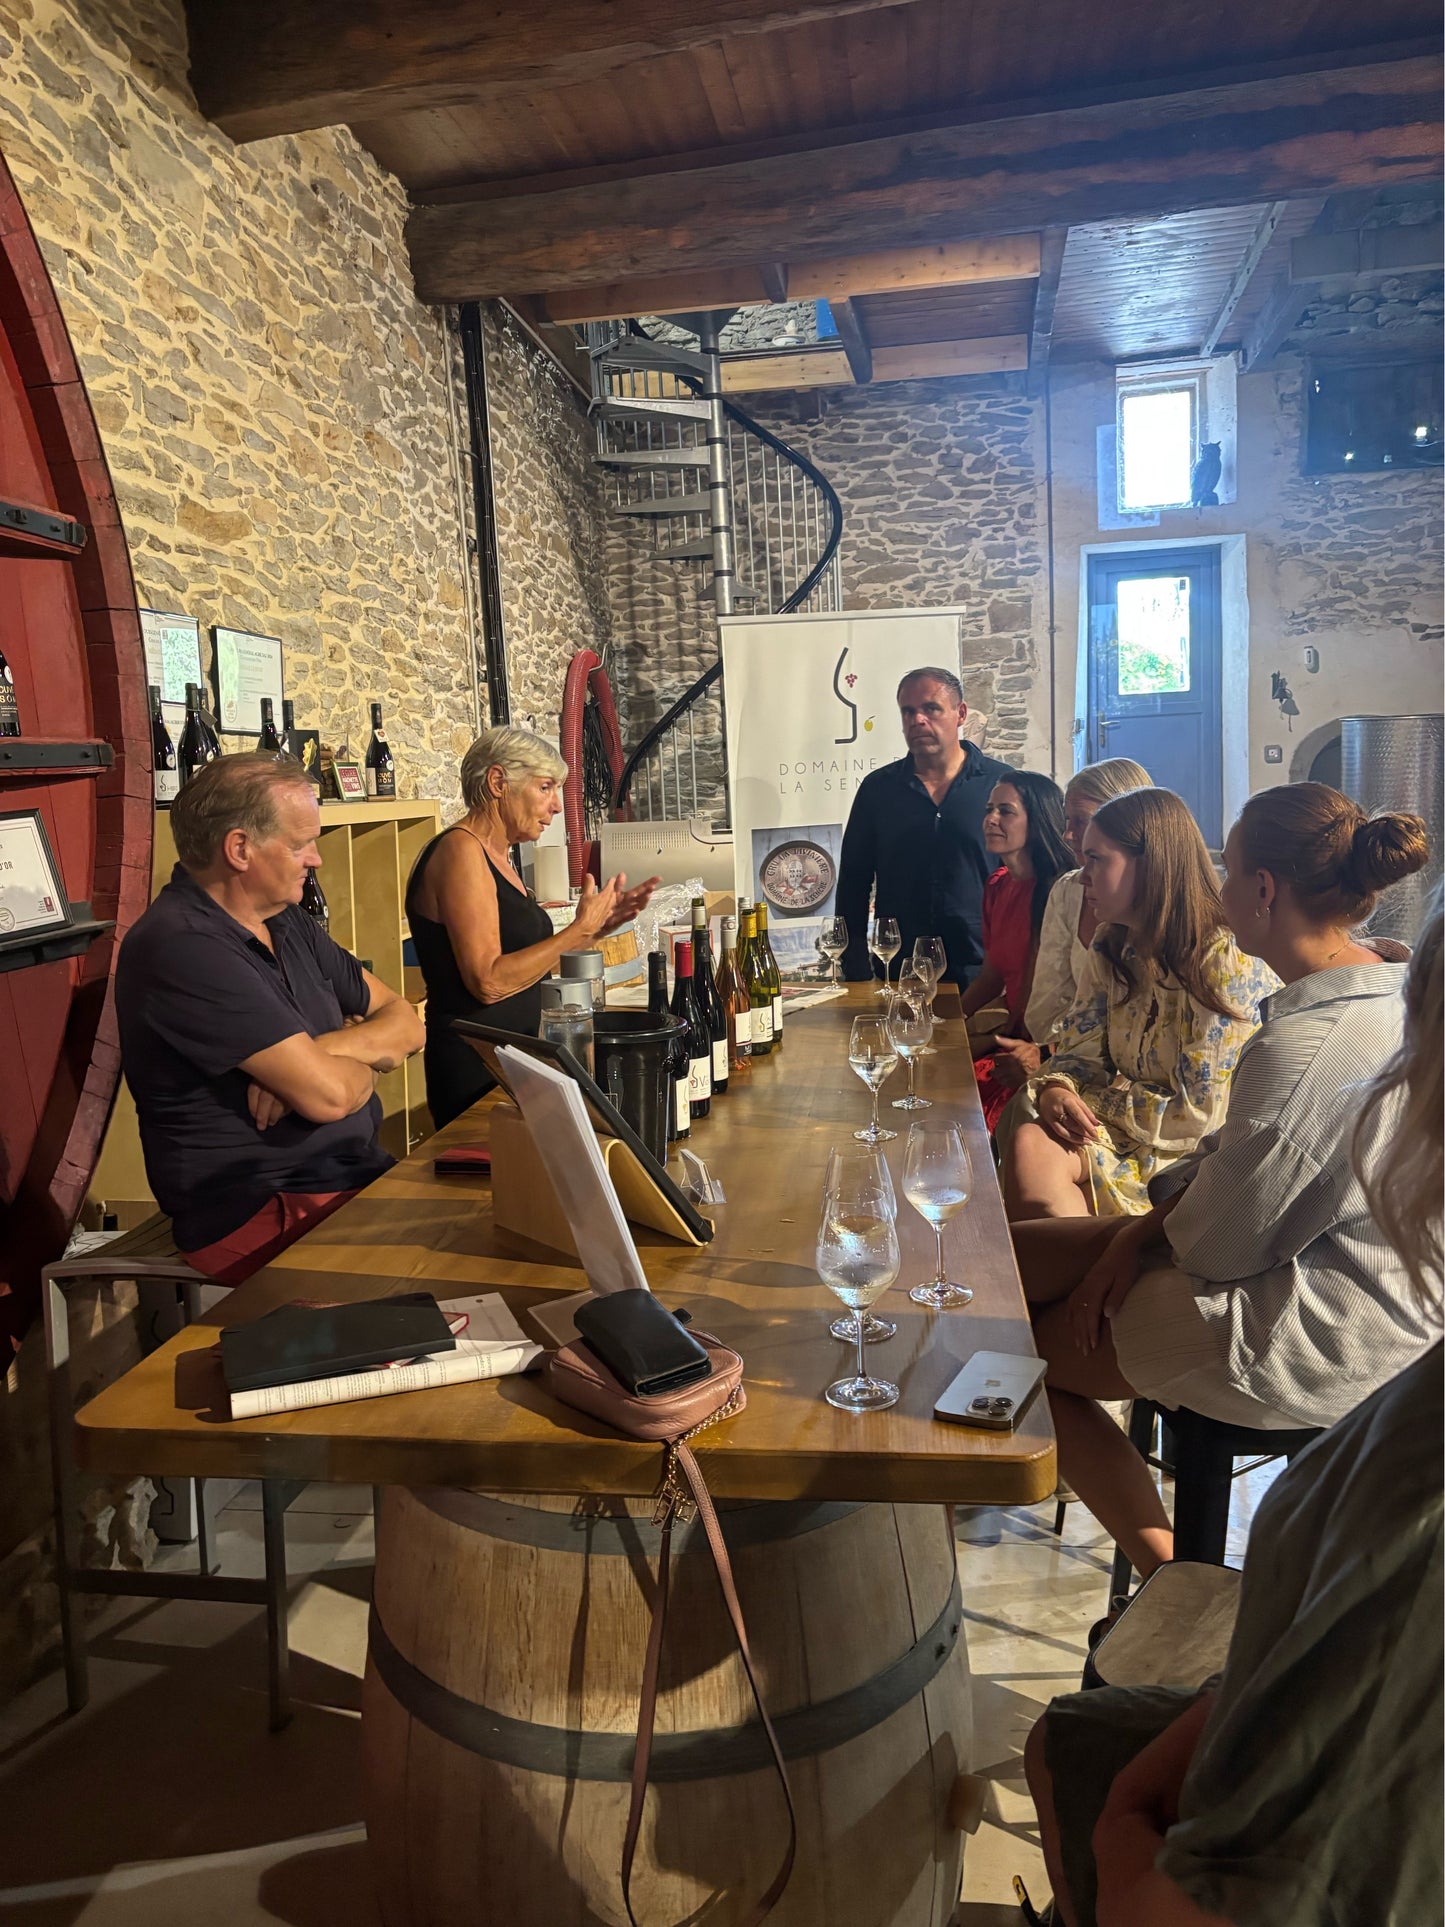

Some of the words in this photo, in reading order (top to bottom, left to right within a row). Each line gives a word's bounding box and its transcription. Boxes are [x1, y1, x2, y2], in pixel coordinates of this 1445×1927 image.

[779, 757, 877, 776] DOMAINE
[780, 781, 804, 794] LA
[767, 882, 787, 904] DOMAINE
[801, 897, 810, 905] LA
